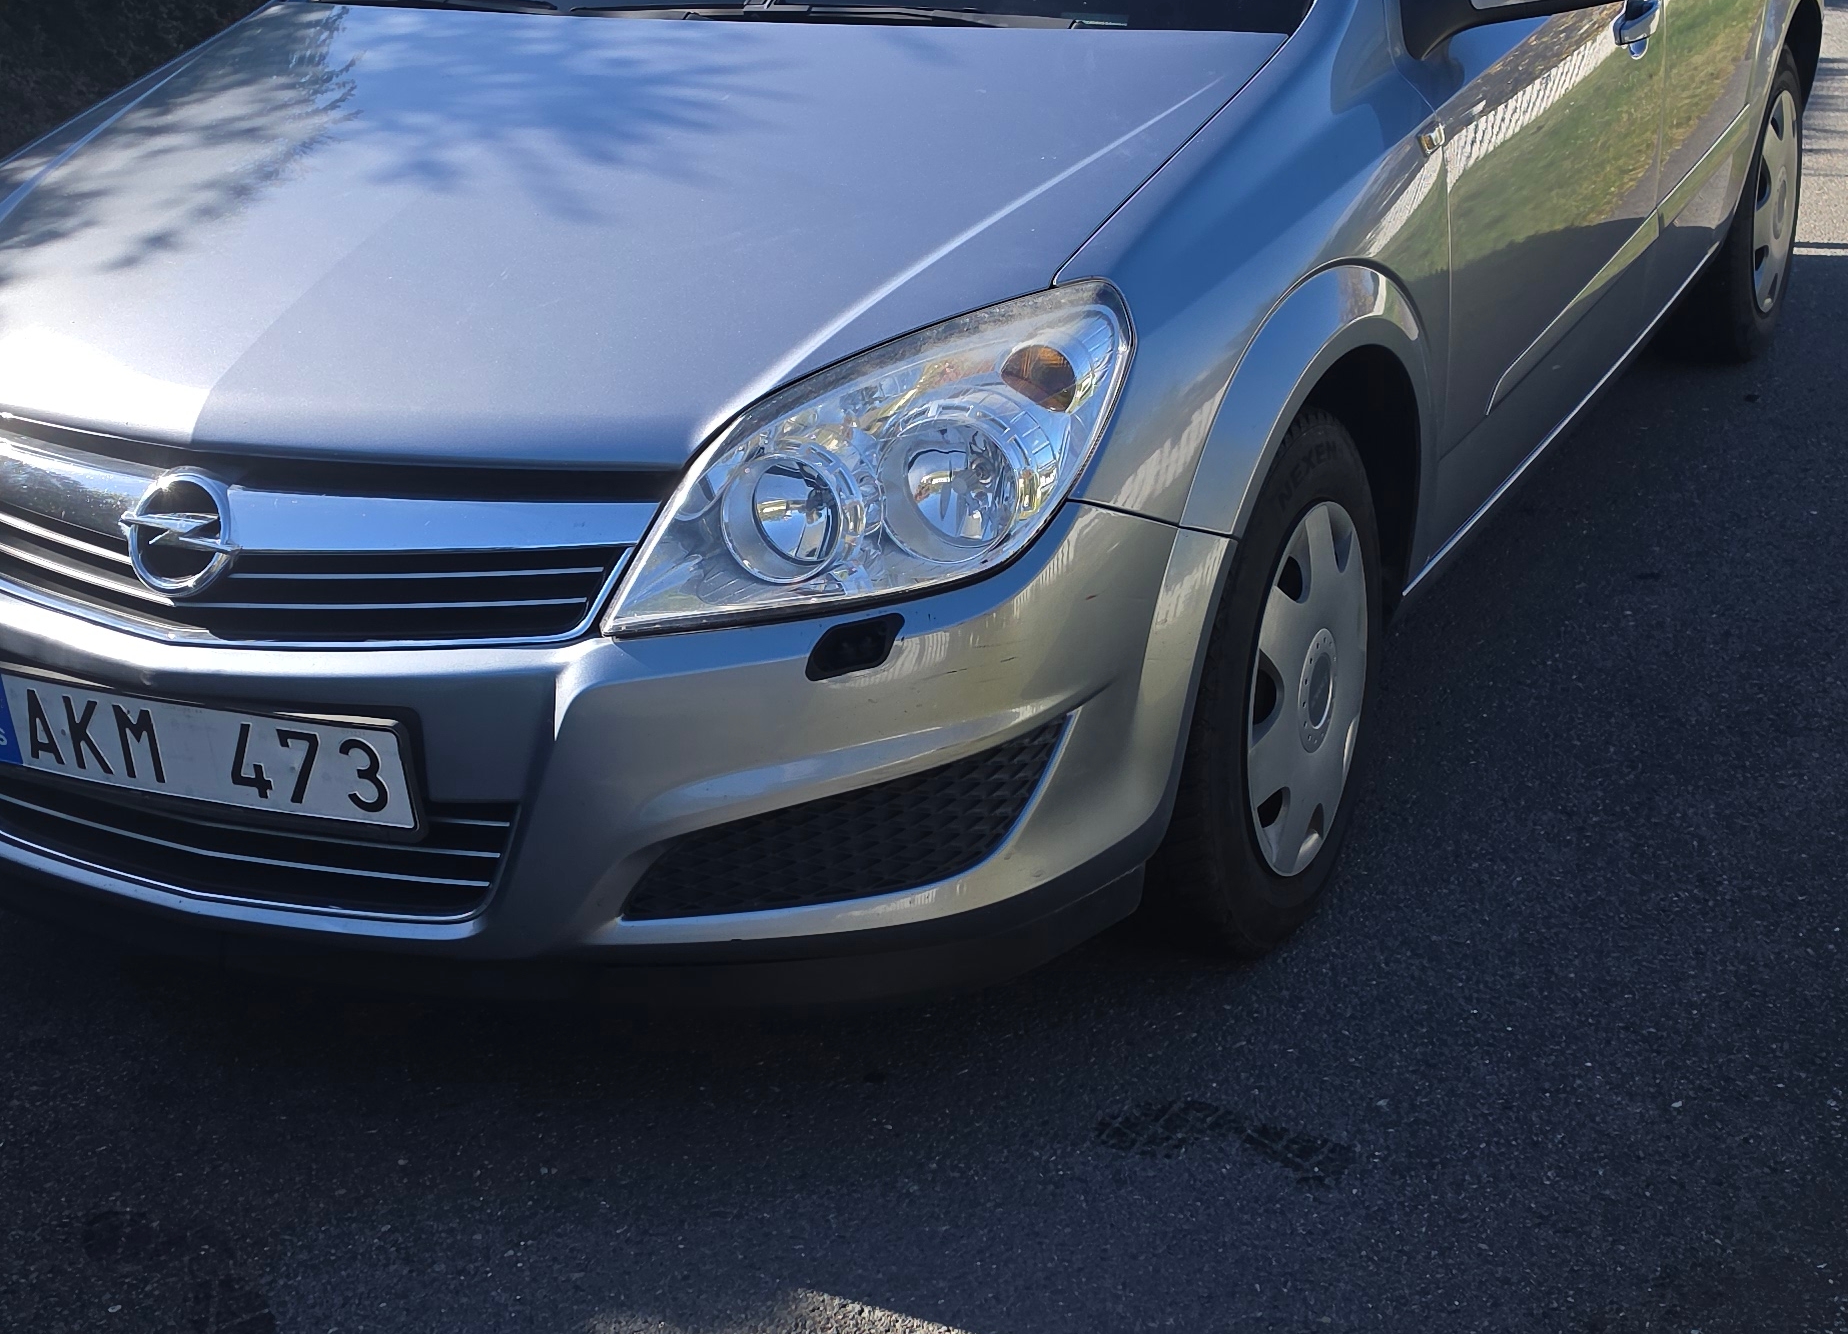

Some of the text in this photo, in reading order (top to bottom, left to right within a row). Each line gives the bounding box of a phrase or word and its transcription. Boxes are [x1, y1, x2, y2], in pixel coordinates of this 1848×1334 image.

[1278, 440, 1338, 513] NEXEN
[26, 688, 390, 814] AKM 473
